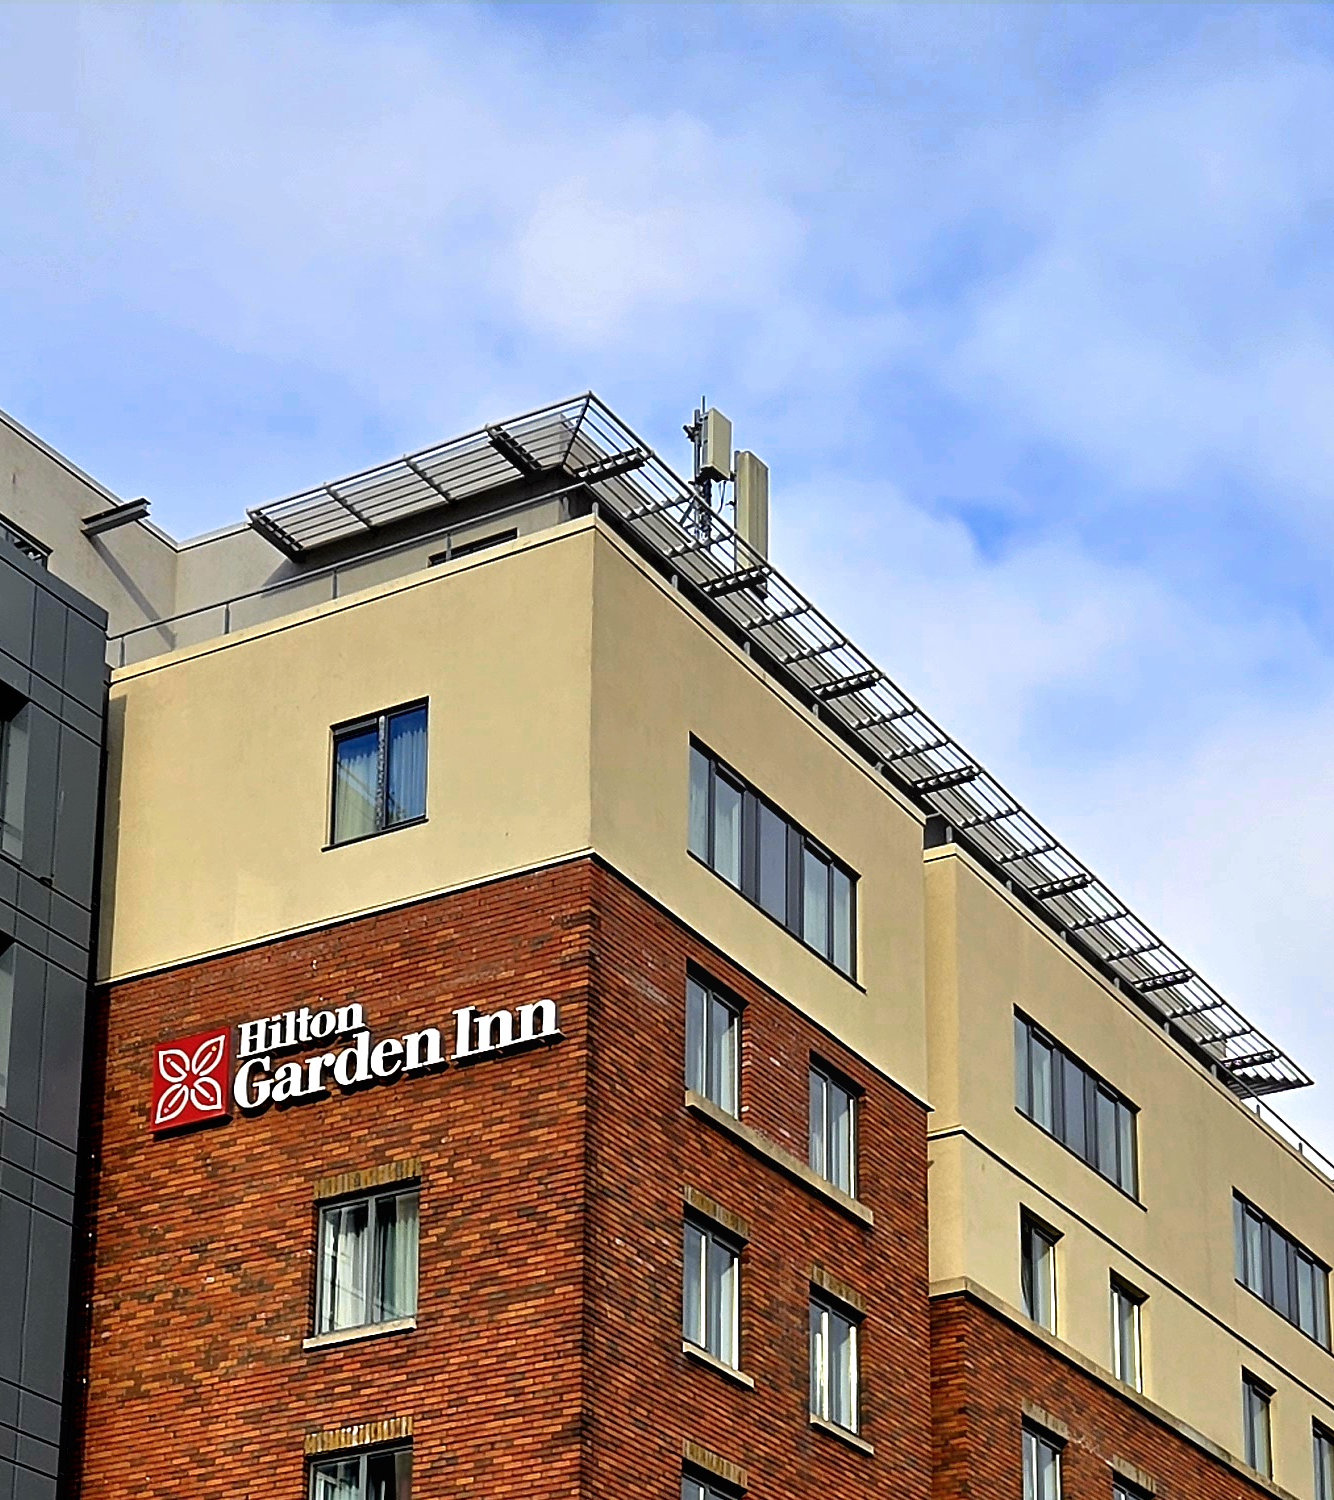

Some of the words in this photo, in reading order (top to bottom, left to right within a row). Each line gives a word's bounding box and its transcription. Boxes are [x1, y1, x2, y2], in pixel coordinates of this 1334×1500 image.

[233, 1026, 445, 1110] Garden
[451, 998, 563, 1060] Inn
[236, 1002, 367, 1060] Hilton
